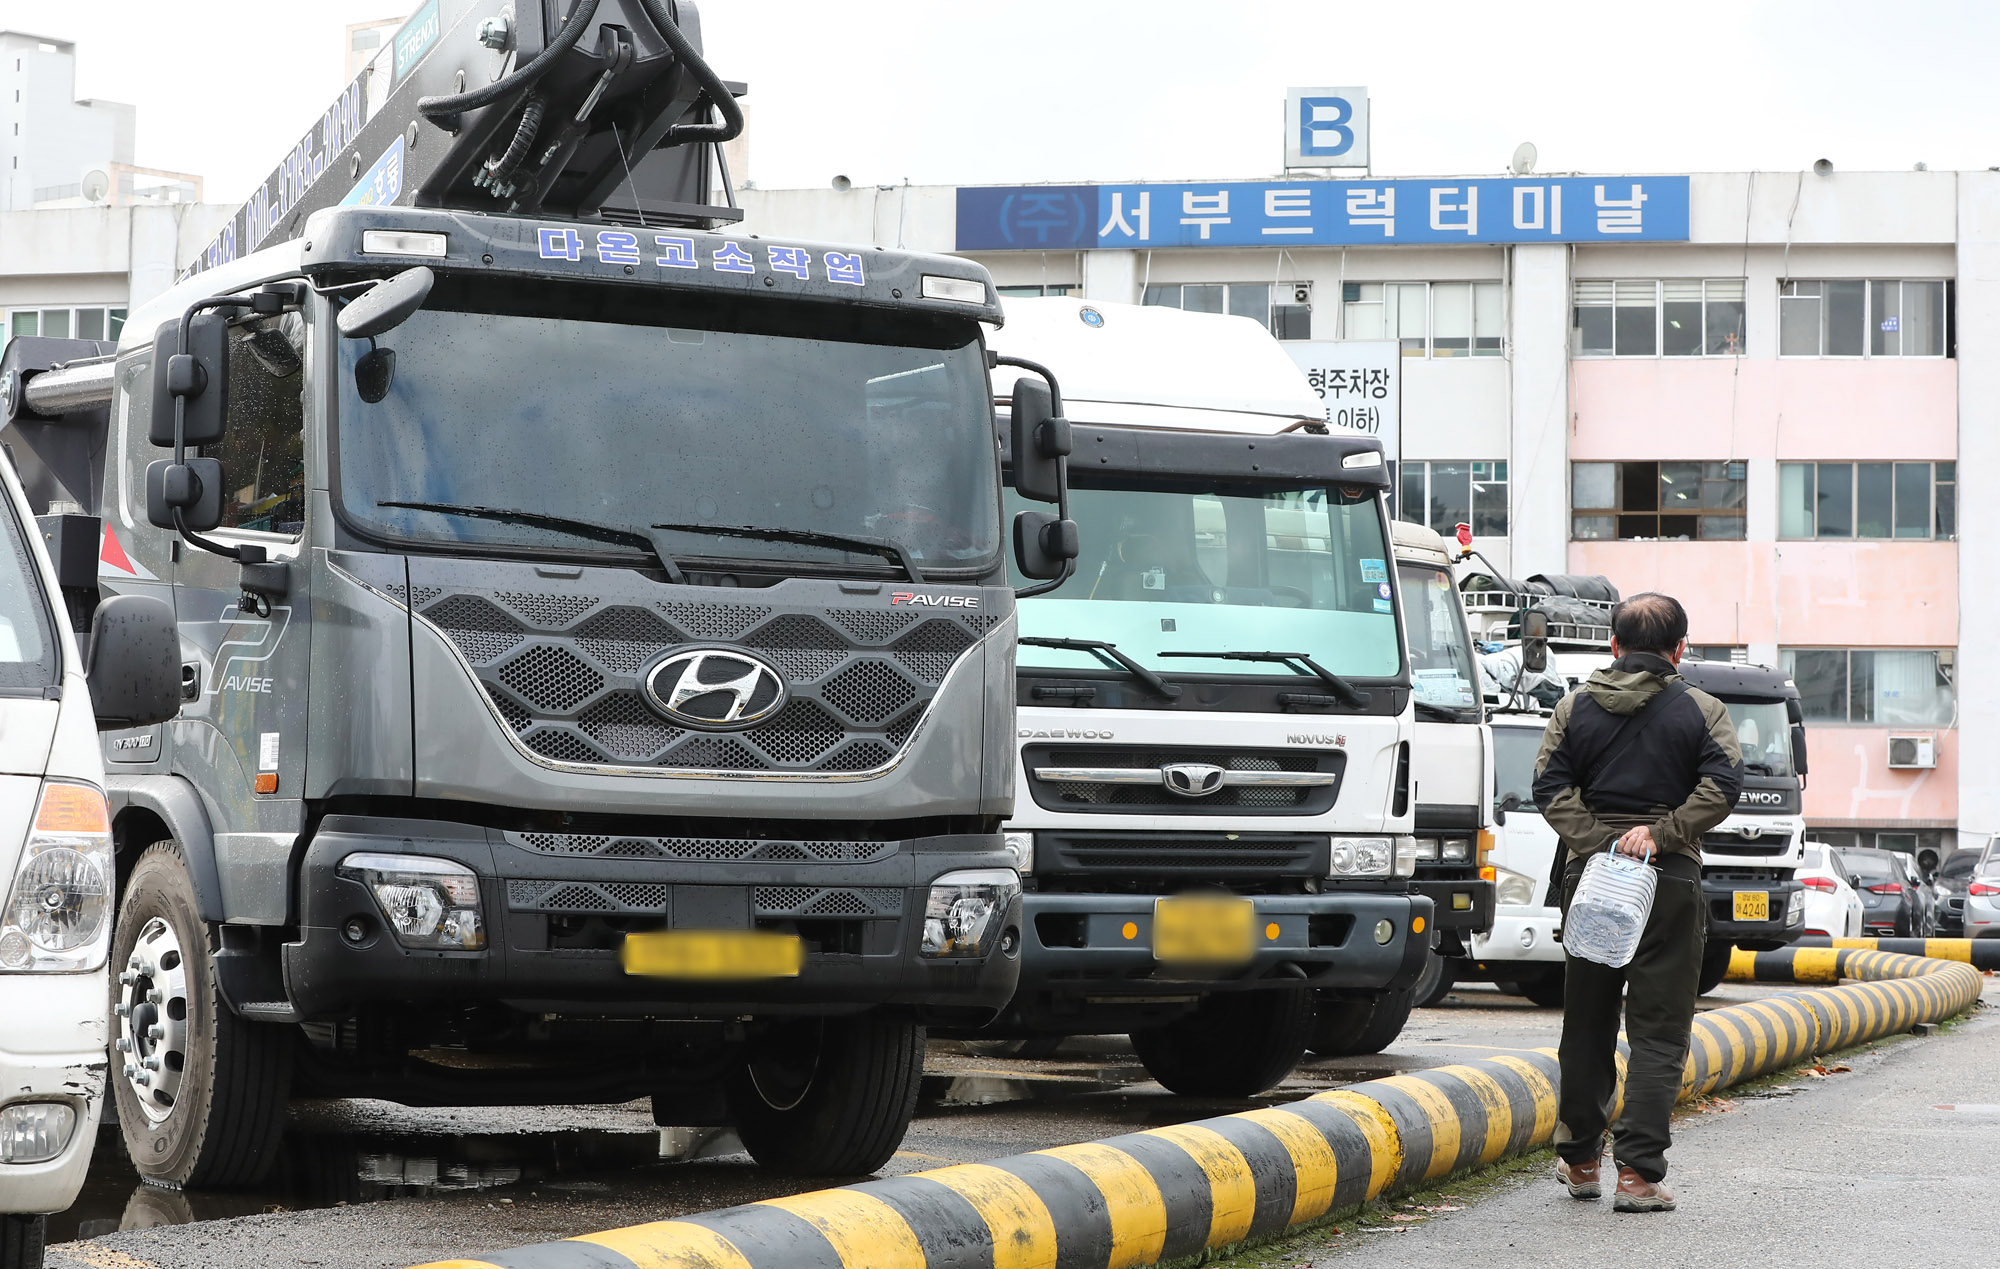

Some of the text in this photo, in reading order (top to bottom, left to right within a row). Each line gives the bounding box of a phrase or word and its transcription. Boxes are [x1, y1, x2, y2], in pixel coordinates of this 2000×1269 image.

[398, 13, 434, 70] STRENX
[1300, 97, 1354, 157] B
[1308, 368, 1389, 399] 형주차장
[891, 592, 979, 608] PAVISE
[1018, 728, 1114, 739] DAEWOO
